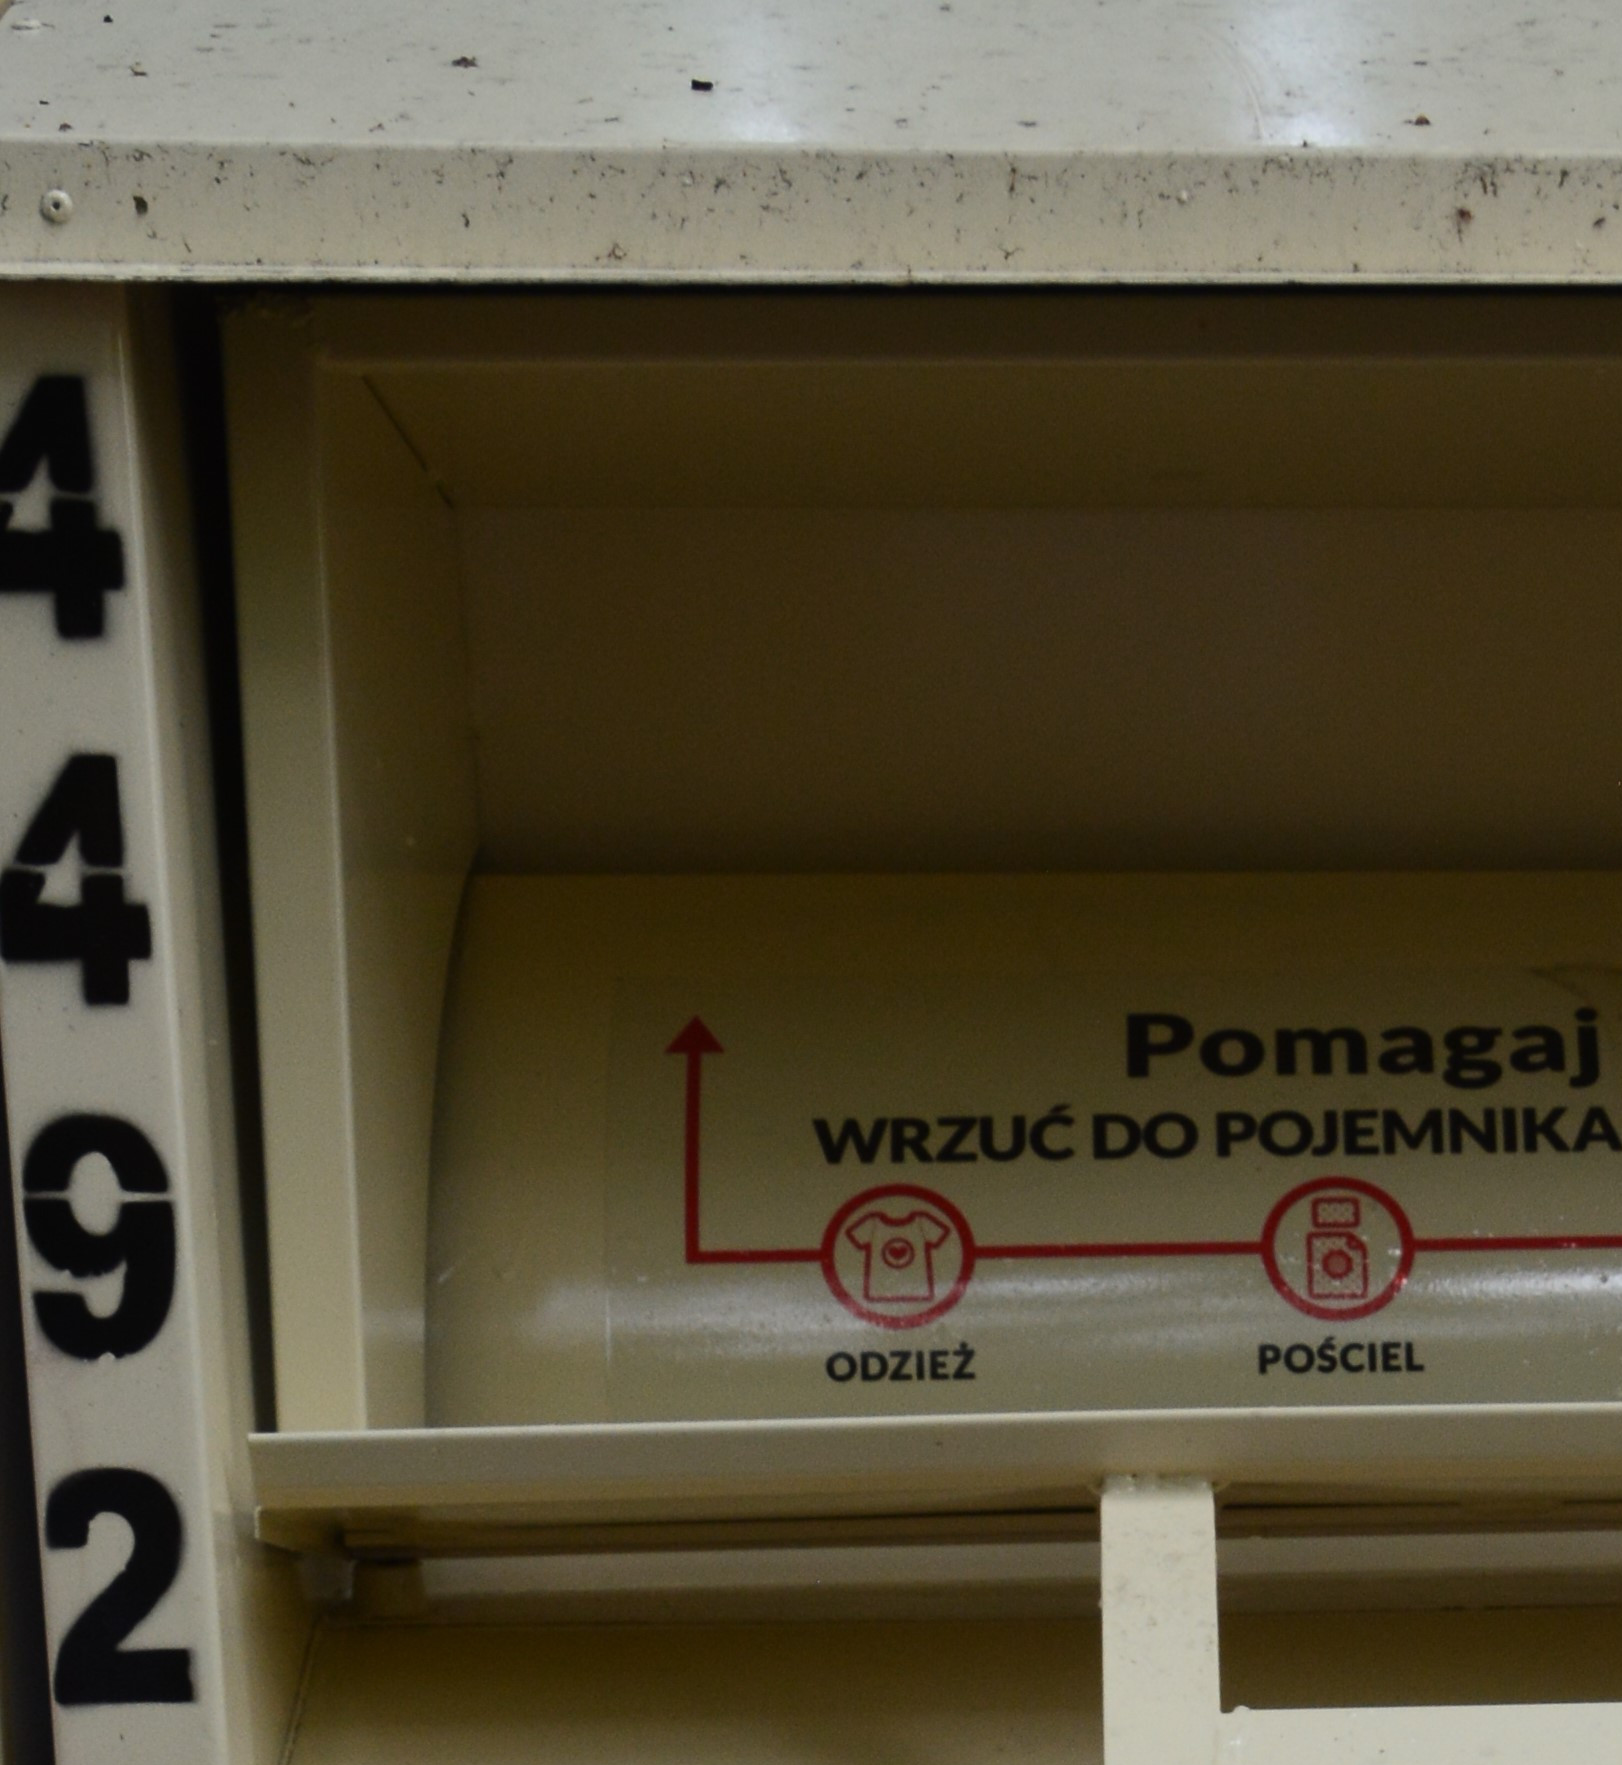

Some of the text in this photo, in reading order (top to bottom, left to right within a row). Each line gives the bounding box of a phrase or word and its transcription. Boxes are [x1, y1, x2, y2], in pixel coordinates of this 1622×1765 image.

[1126, 1006, 1599, 1089] Pomagaj
[813, 1104, 1074, 1164] WRZUĆ
[1093, 1112, 1198, 1159] DO
[1216, 1106, 1622, 1157] POJEMNIKA
[826, 1342, 976, 1383] ODZIEŻ
[1258, 1337, 1424, 1375] POŚCIEL
